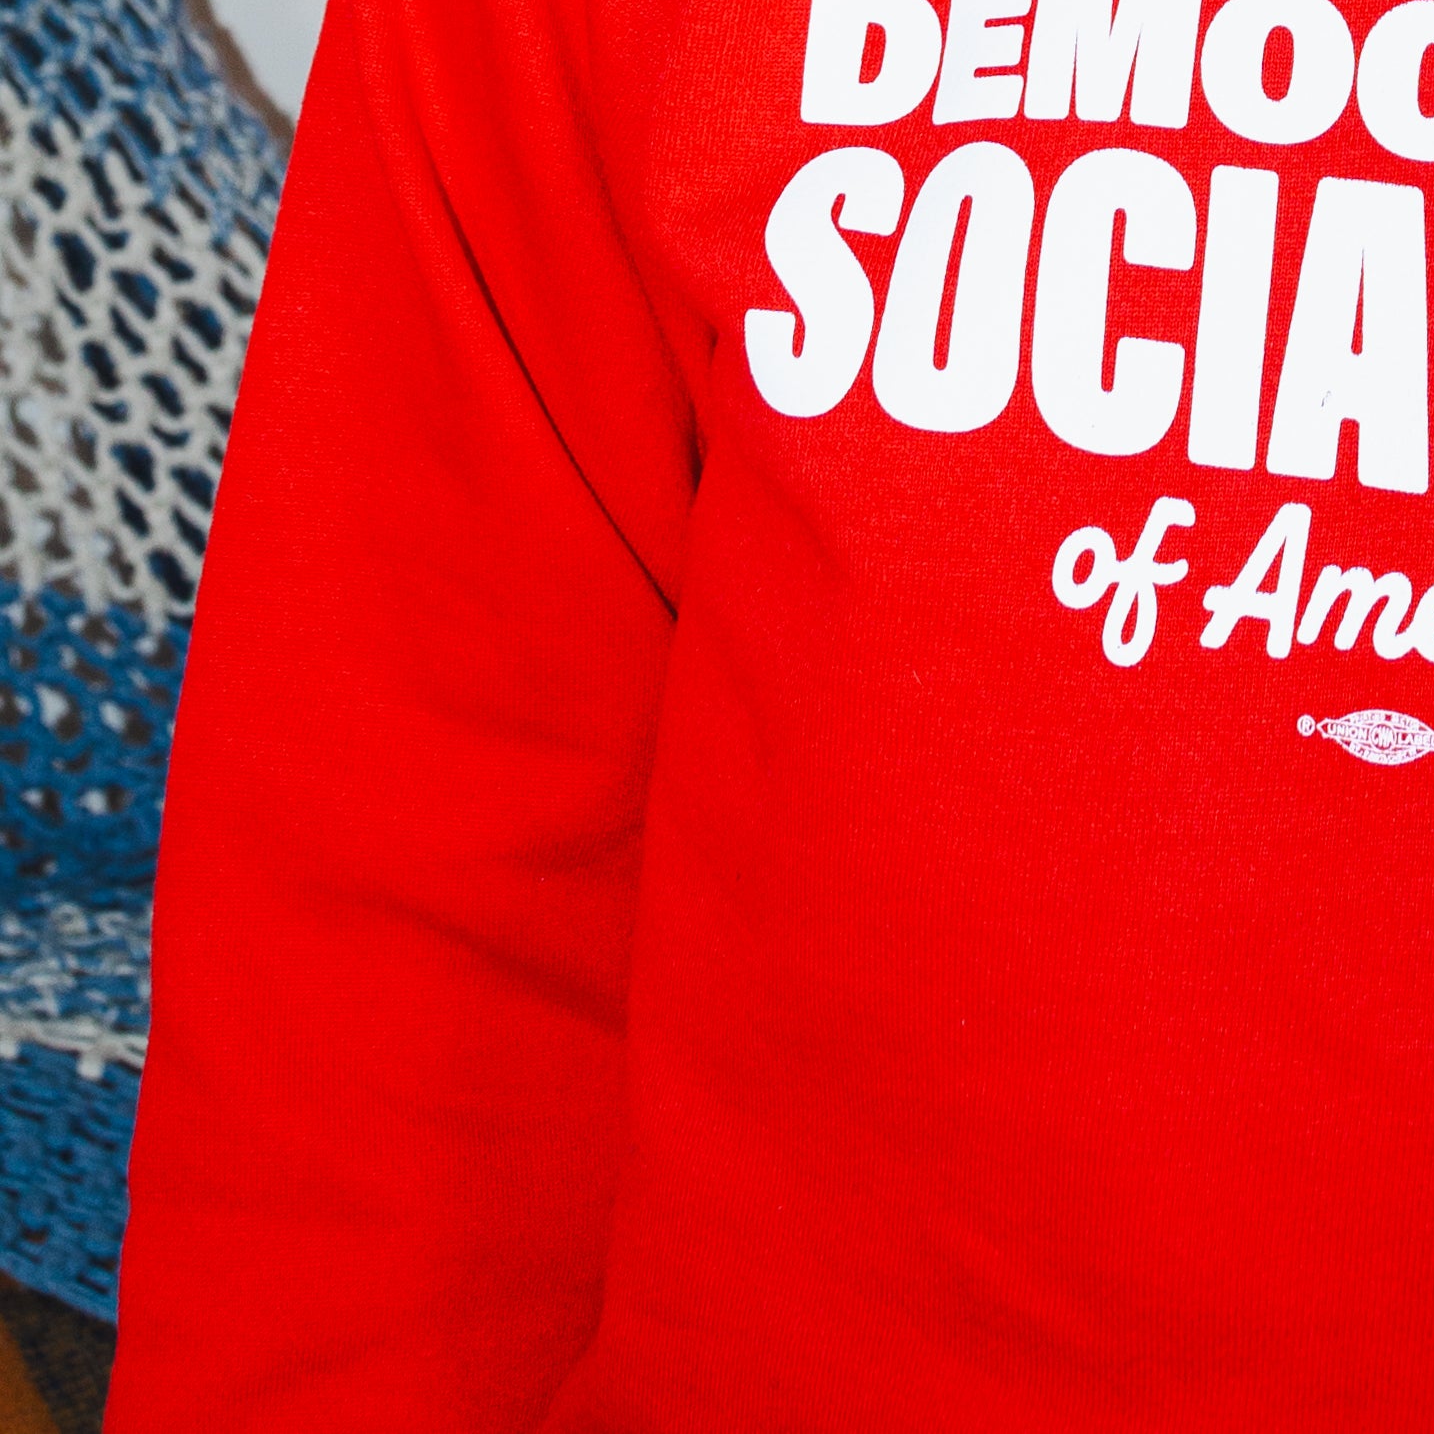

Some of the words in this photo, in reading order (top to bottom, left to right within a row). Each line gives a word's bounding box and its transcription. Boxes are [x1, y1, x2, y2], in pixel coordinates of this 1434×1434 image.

[1051, 496, 1196, 667] of
[1327, 723, 1370, 741] UNION
[1373, 725, 1396, 749] CWA
